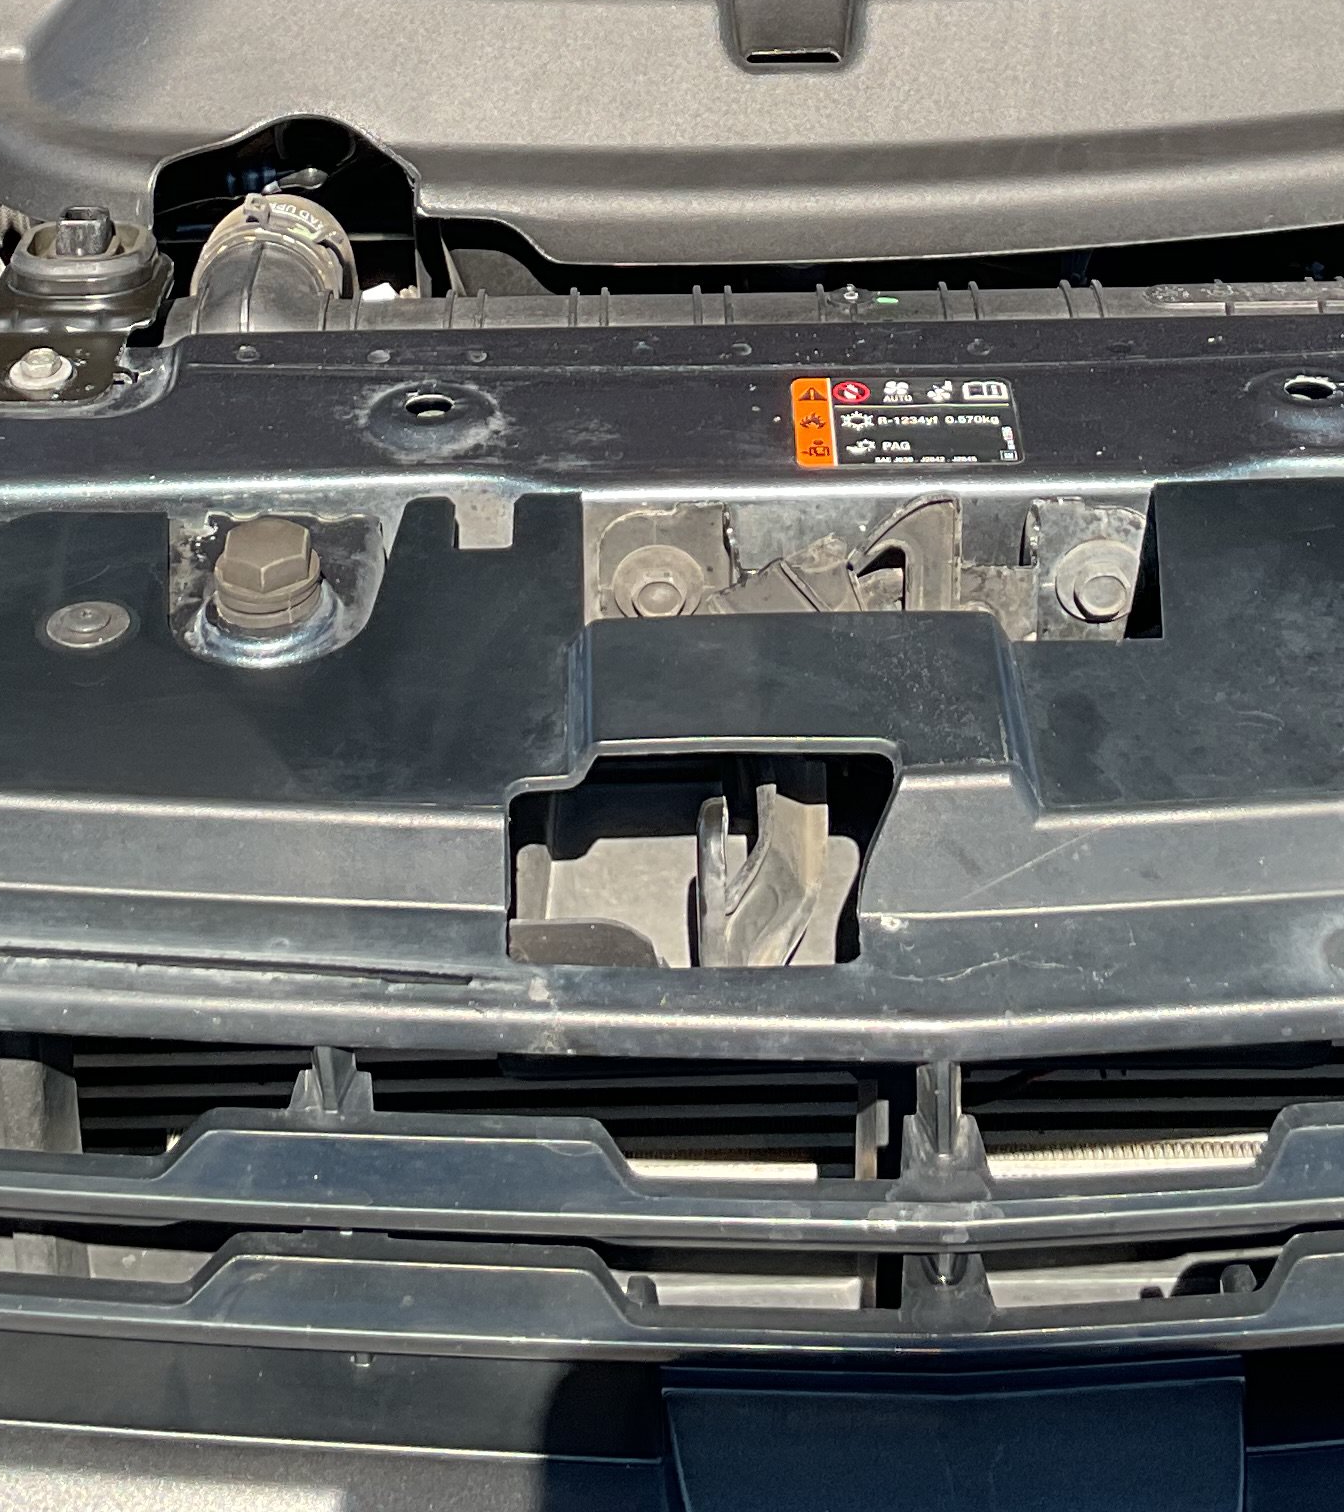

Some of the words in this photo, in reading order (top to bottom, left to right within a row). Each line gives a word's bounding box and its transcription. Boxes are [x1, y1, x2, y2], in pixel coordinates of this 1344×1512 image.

[883, 394, 913, 403] AUTO
[944, 415, 1000, 426] 0.570kg
[882, 441, 911, 451] PAG
